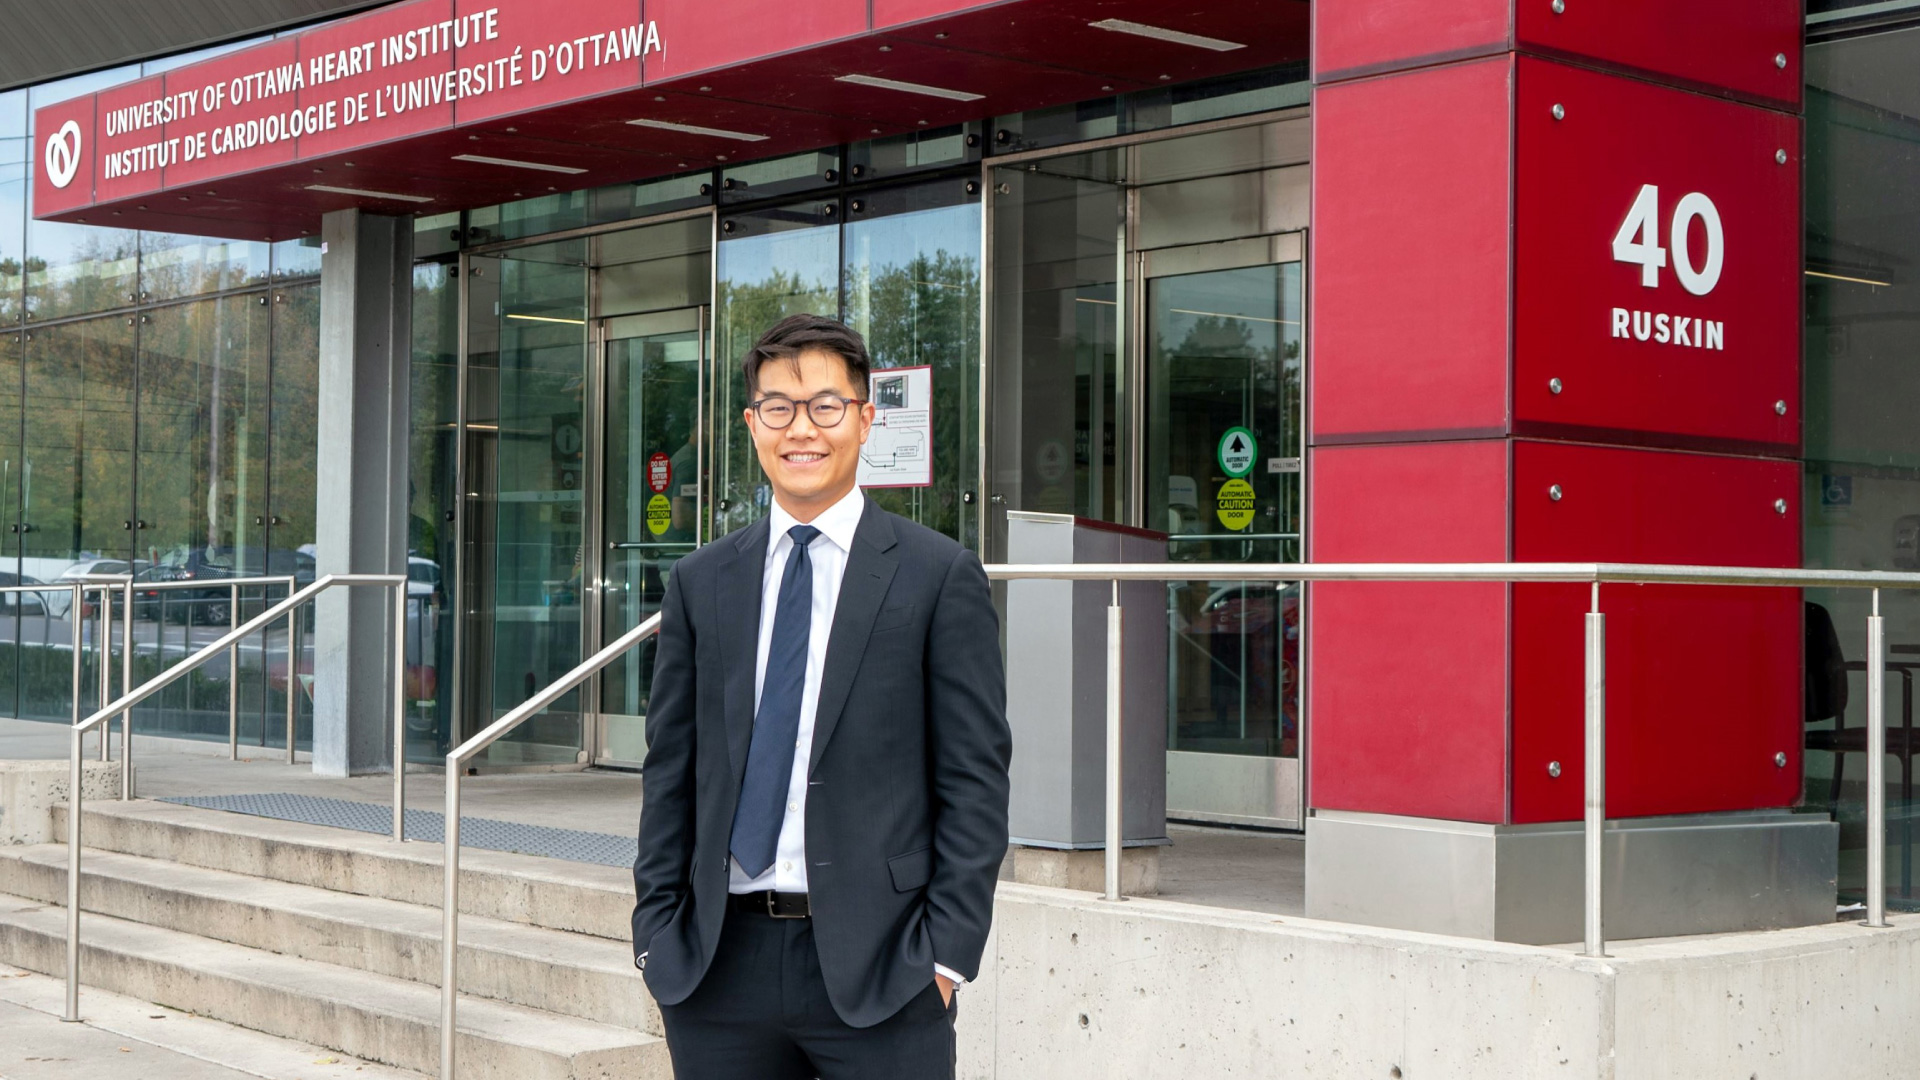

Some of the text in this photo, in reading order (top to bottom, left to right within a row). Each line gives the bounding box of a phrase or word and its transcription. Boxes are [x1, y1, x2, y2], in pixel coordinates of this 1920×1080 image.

[106, 7, 499, 137] UNIVERSITY OF OTTAWA HEART INSTITUTE
[104, 138, 180, 180] INSTITUT
[184, 131, 207, 162] DE
[211, 101, 337, 155] CARDIOLOGIE
[343, 92, 369, 126] DE
[1612, 184, 1725, 296] 40
[1612, 307, 1724, 351] RUSKIN
[1219, 500, 1253, 509] CAUTION
